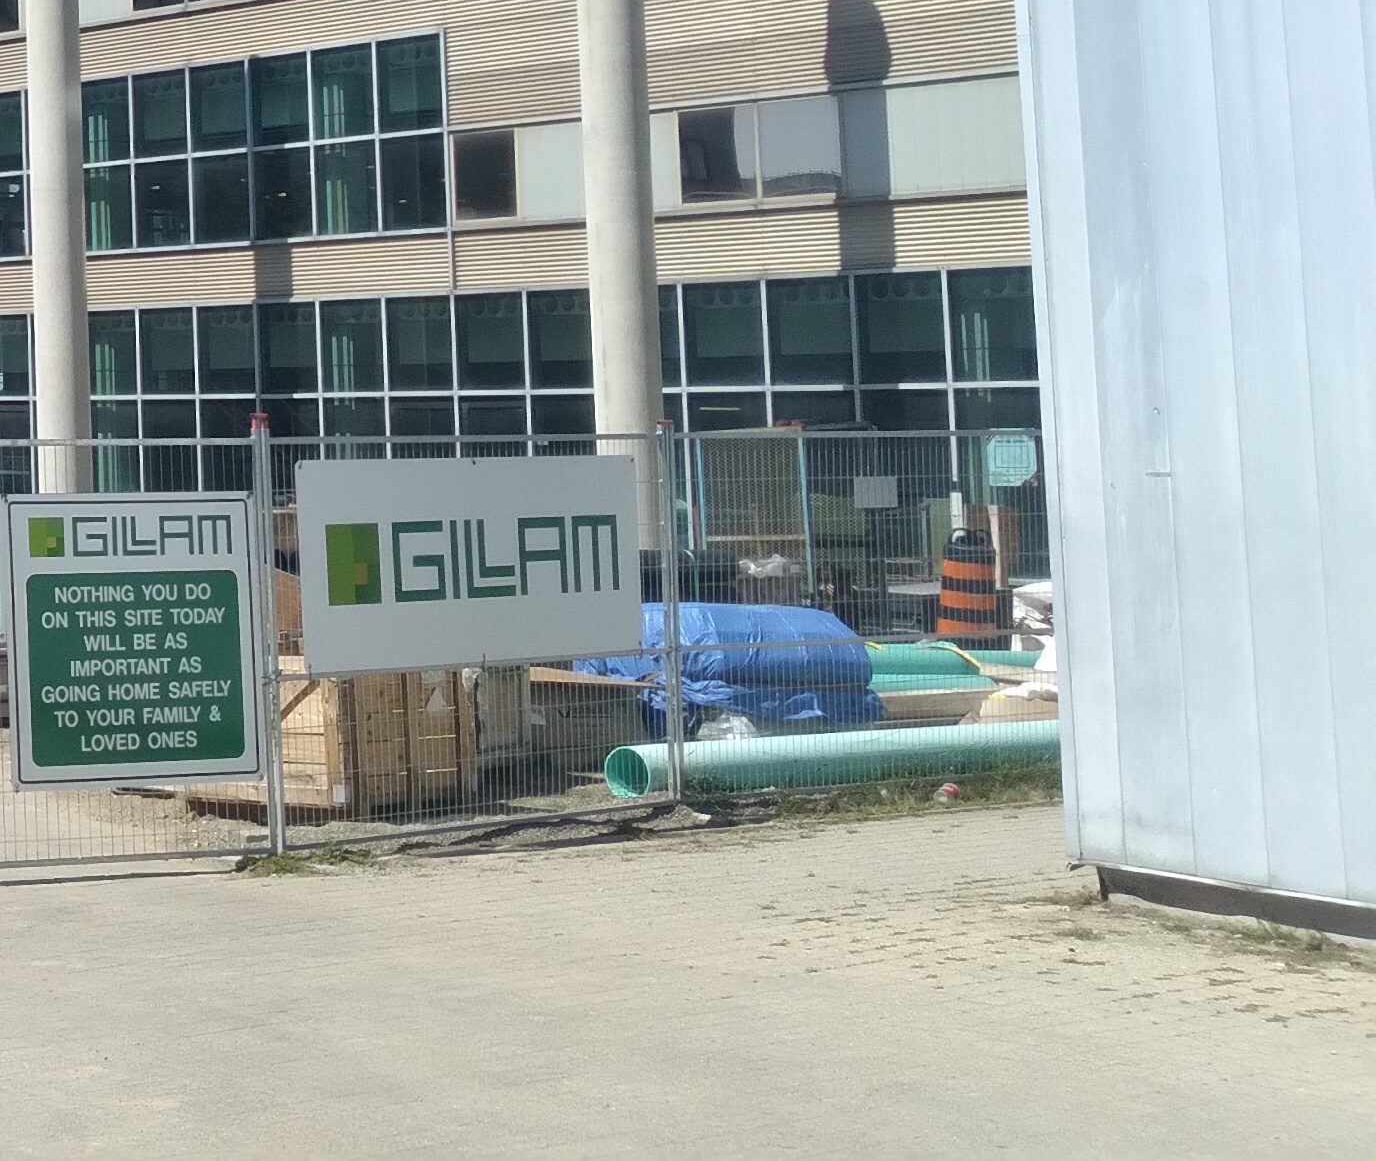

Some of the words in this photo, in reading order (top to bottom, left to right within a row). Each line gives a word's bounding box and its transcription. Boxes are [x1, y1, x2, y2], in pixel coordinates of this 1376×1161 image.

[72, 515, 233, 557] GILLAM
[391, 514, 620, 603] GILLAM
[54, 585, 134, 604] NOTHING
[142, 584, 178, 601] YOU
[185, 583, 211, 600] DO
[41, 611, 68, 629] ON
[75, 610, 116, 628] THIS
[124, 609, 163, 627] SITE
[170, 607, 226, 626] TODAY
[84, 634, 126, 652] WILL
[133, 634, 157, 650] BE
[164, 632, 188, 649] AS
[70, 658, 171, 677] IMPORTANT
[178, 656, 202, 674] AS
[41, 685, 100, 703] GOING
[108, 683, 161, 701] HOME
[168, 680, 232, 698] SAFELY
[54, 710, 79, 728] TO
[86, 708, 135, 727] YOUR
[143, 705, 201, 724] FAMILY
[209, 705, 221, 722] &
[81, 734, 140, 752] LOVED
[147, 731, 198, 749] ONES
